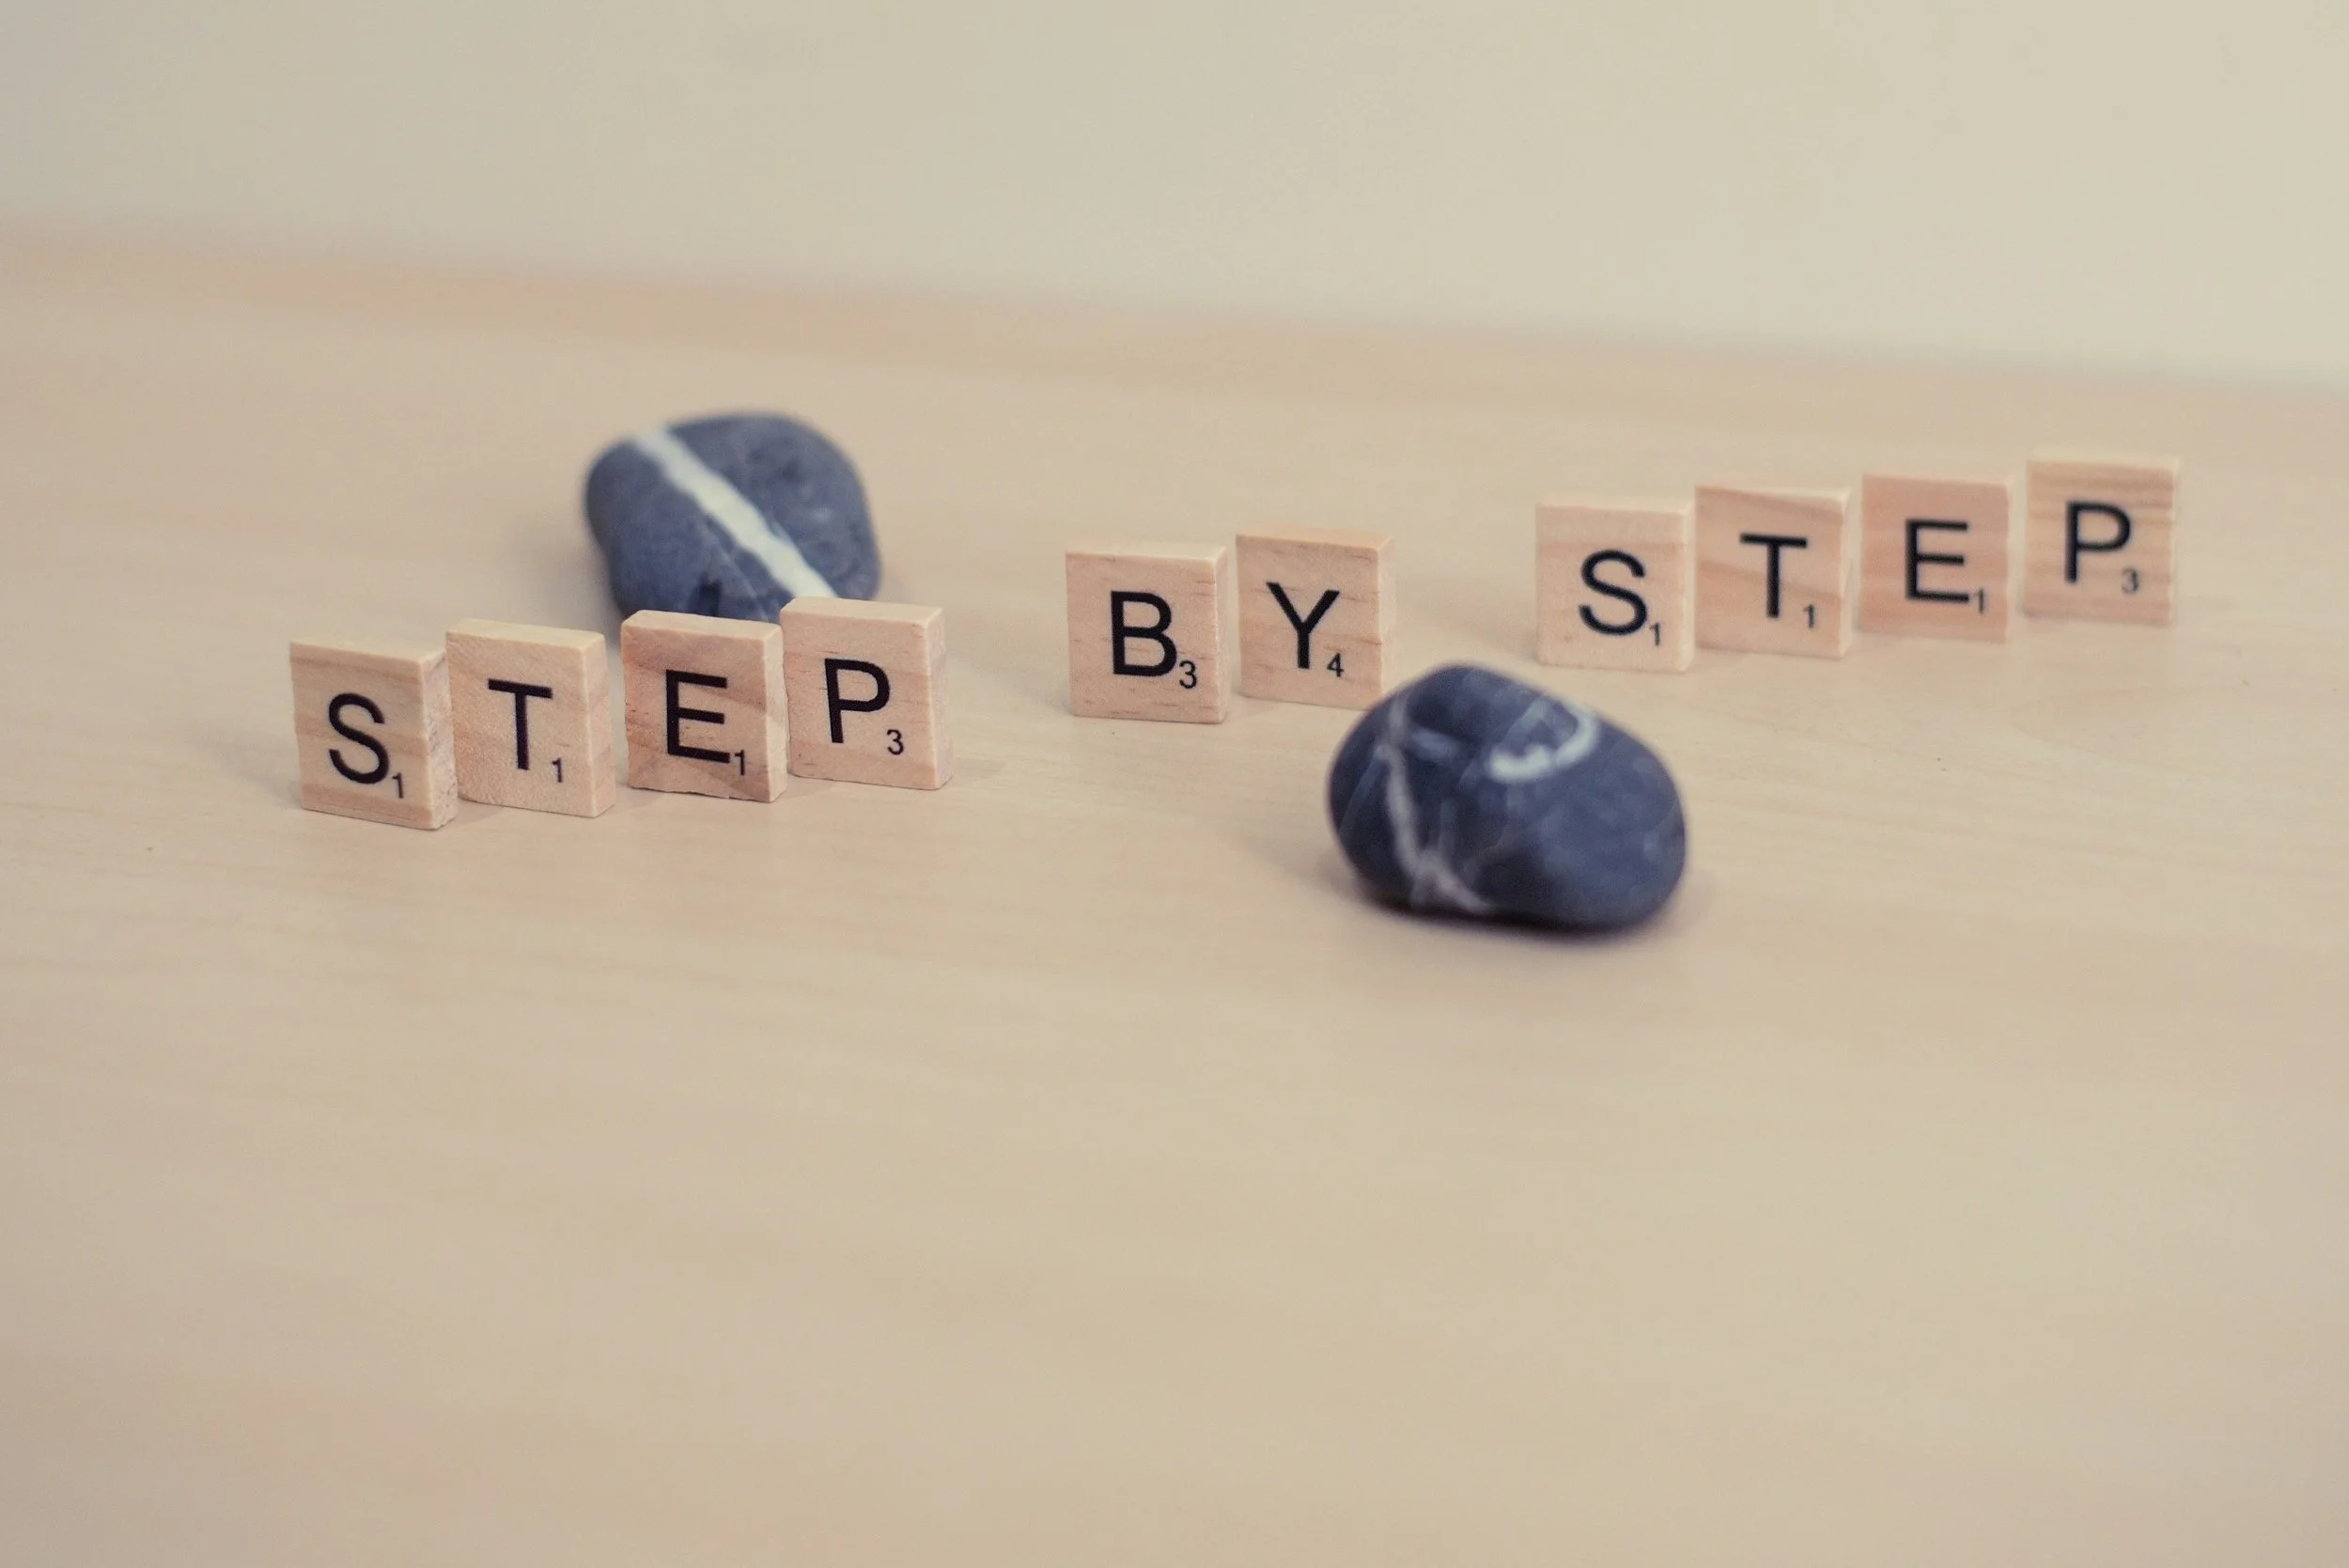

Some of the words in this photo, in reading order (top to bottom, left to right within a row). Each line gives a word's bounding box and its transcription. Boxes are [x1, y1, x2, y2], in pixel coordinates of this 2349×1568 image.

[2123, 568, 2140, 594] 3
[1974, 589, 1985, 613] 1
[1805, 604, 1816, 629] 1
[1649, 622, 1662, 646] 1
[1178, 660, 1198, 691] 3
[1325, 652, 1345, 678] 4
[886, 728, 905, 756] 3
[551, 757, 564, 784] 1
[732, 749, 747, 777] 1
[391, 772, 405, 800] 1
